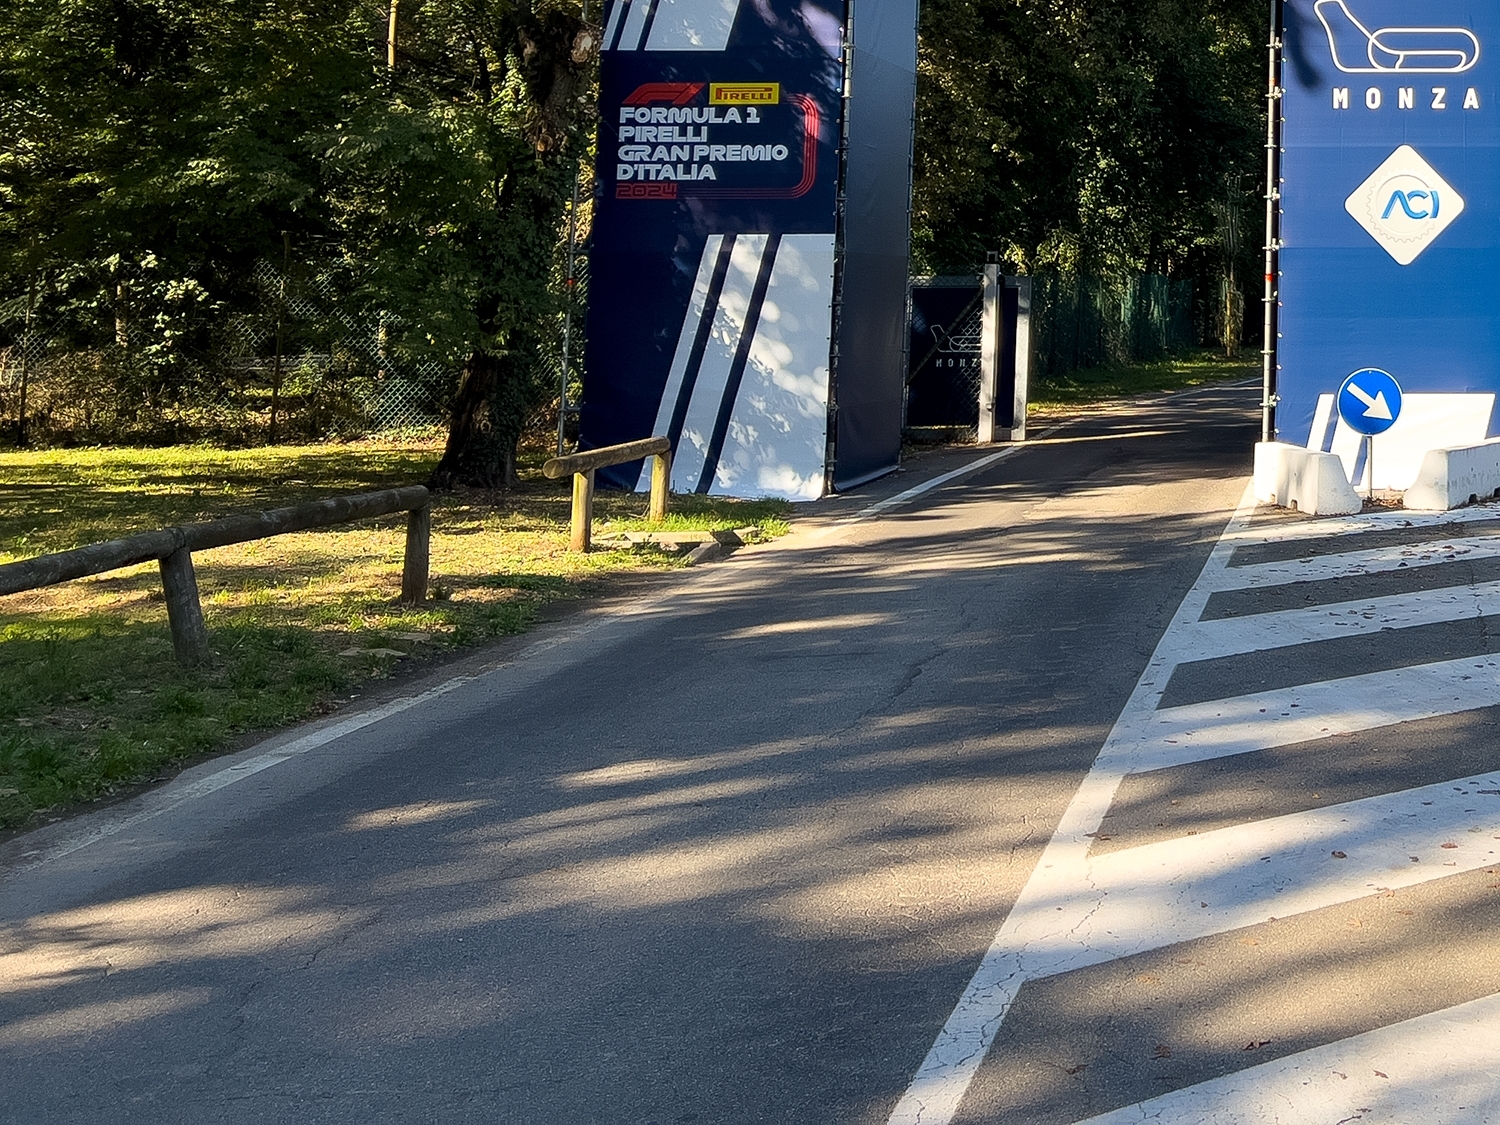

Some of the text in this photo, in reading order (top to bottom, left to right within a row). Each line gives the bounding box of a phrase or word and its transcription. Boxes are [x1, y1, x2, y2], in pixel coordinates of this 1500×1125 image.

[716, 87, 773, 101] PIRELLI
[1332, 88, 1480, 109] MONZA
[620, 107, 760, 123] FORMULA 1
[618, 126, 707, 142] PIRELLI
[617, 144, 788, 161] GRAN PREMIO
[616, 164, 716, 180] D'ITALIA
[616, 184, 677, 198] 2024
[1381, 189, 1440, 220] ACI
[936, 358, 978, 368] MONZ
